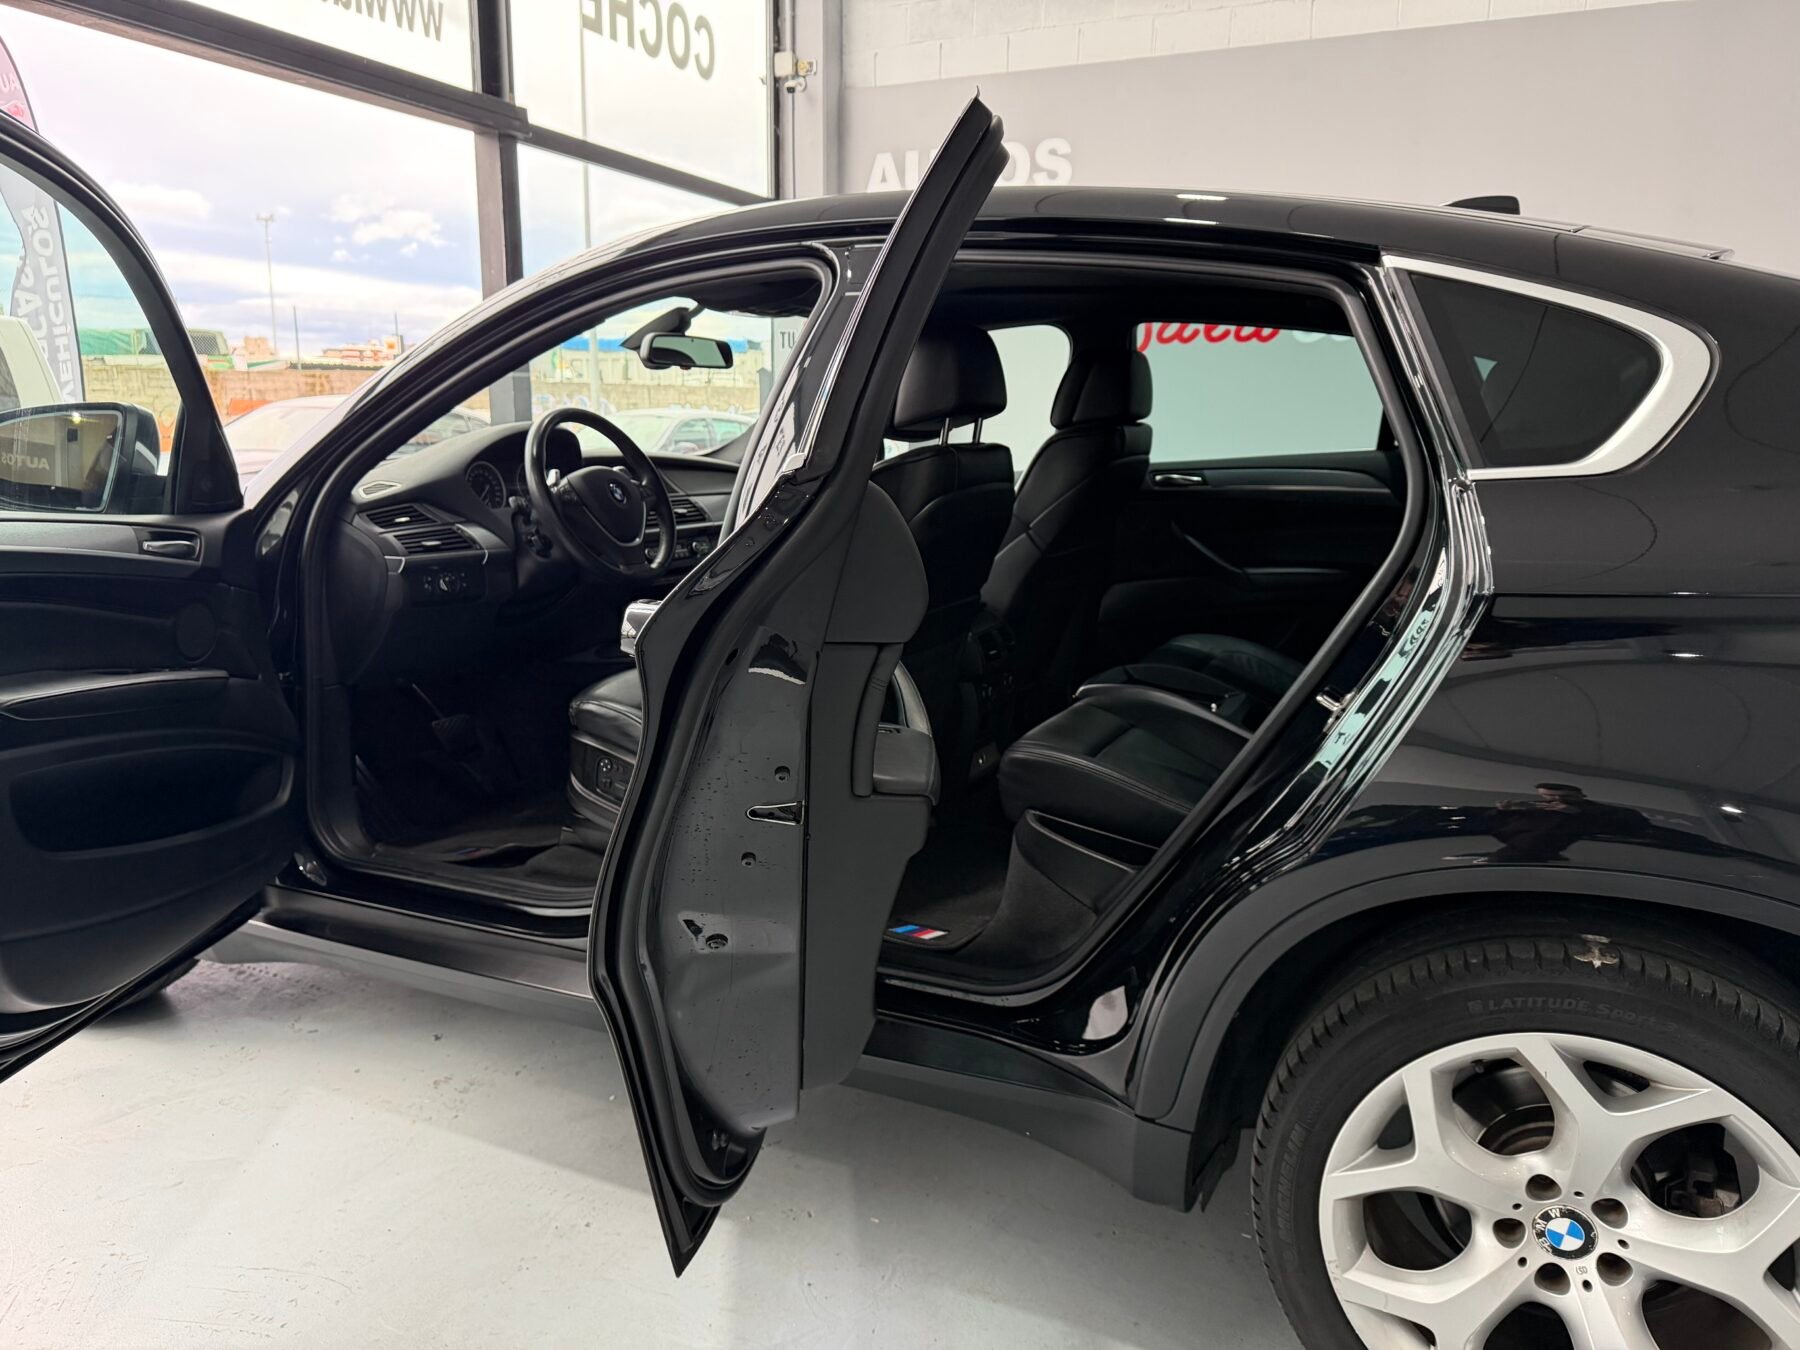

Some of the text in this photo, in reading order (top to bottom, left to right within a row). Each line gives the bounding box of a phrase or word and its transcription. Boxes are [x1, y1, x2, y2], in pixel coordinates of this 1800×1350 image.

[866, 137, 1073, 193] AOS
[1488, 997, 1590, 1011] LATITUDE
[1276, 1122, 1307, 1245] MICHELIN
[1534, 1208, 1561, 1254] BMW
